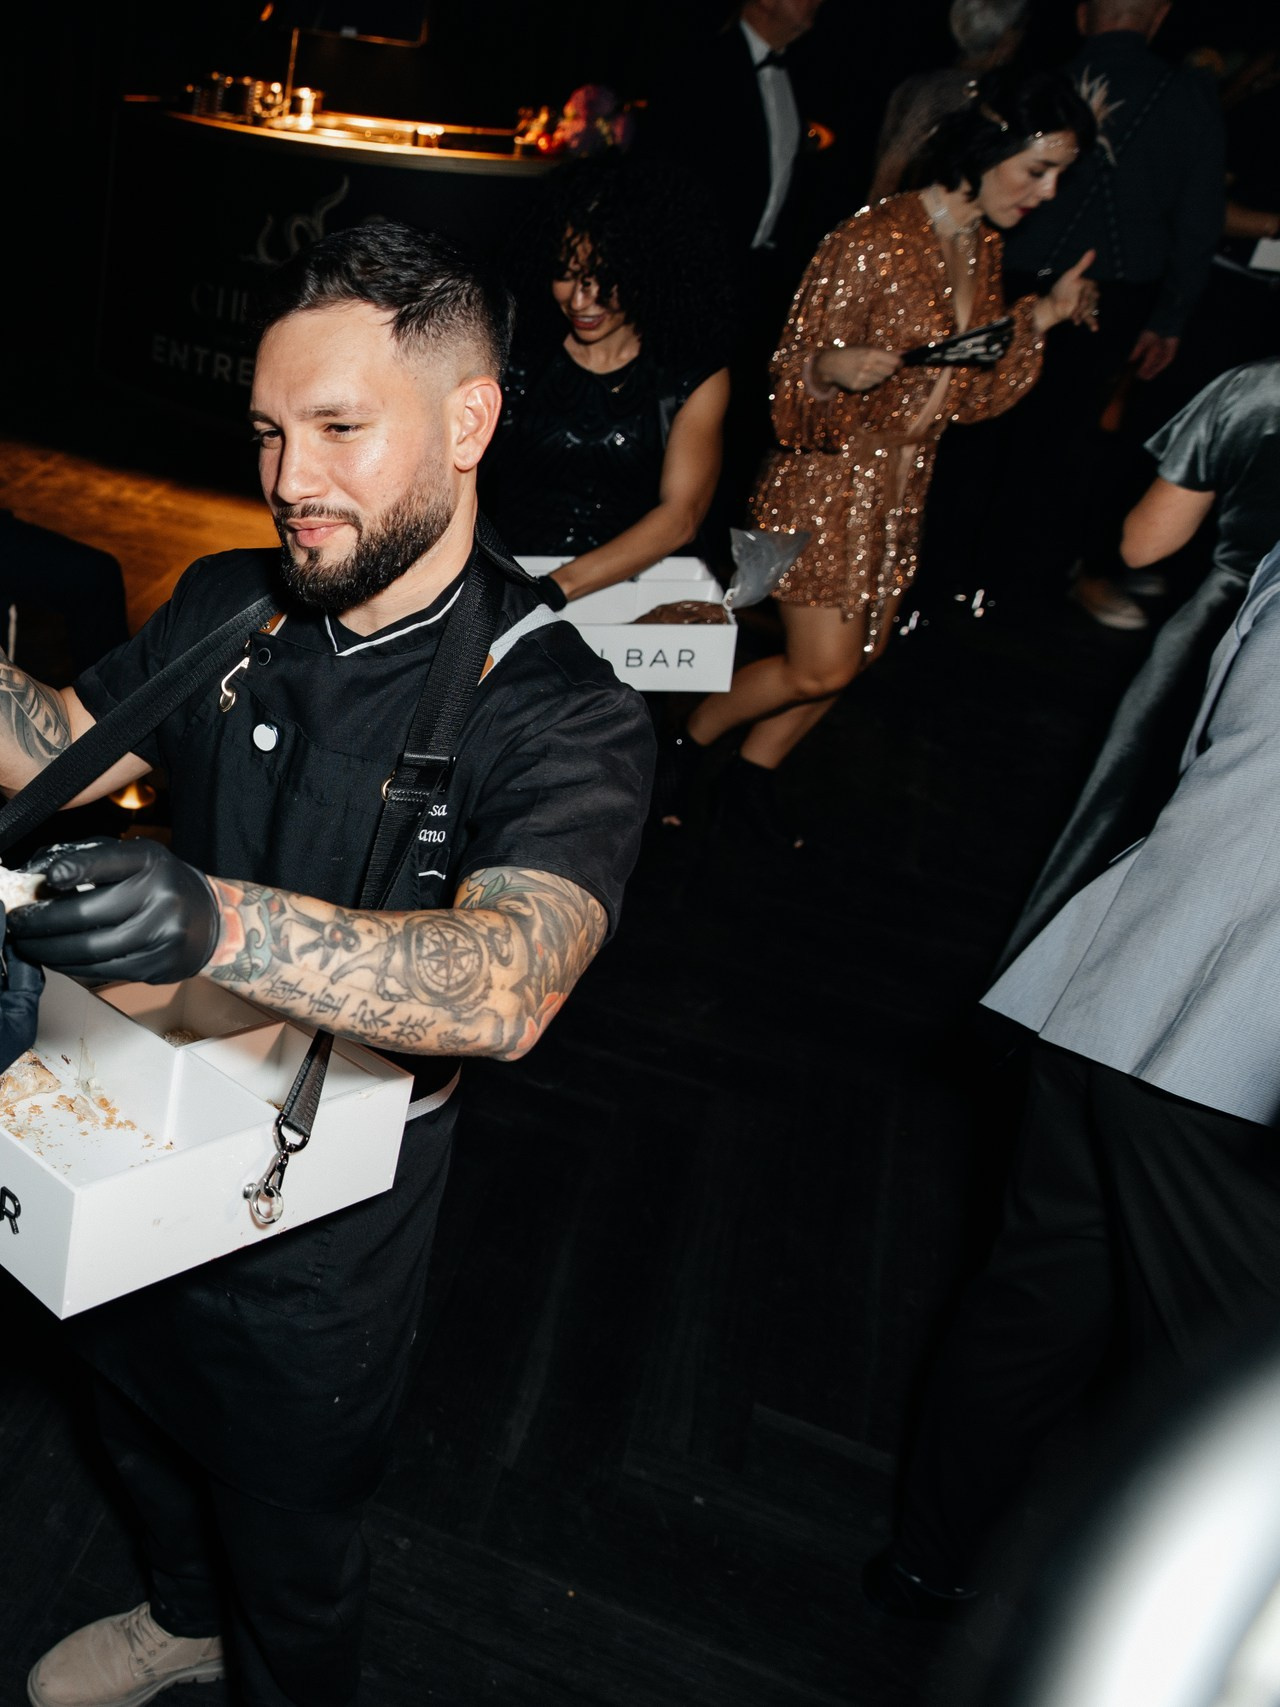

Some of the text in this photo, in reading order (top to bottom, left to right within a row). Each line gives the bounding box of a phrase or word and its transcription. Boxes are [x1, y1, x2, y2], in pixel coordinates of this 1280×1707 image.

[150, 332, 255, 388] ENTRE
[625, 648, 696, 668] BAR
[428, 803, 449, 817] sa
[417, 828, 447, 844] ano
